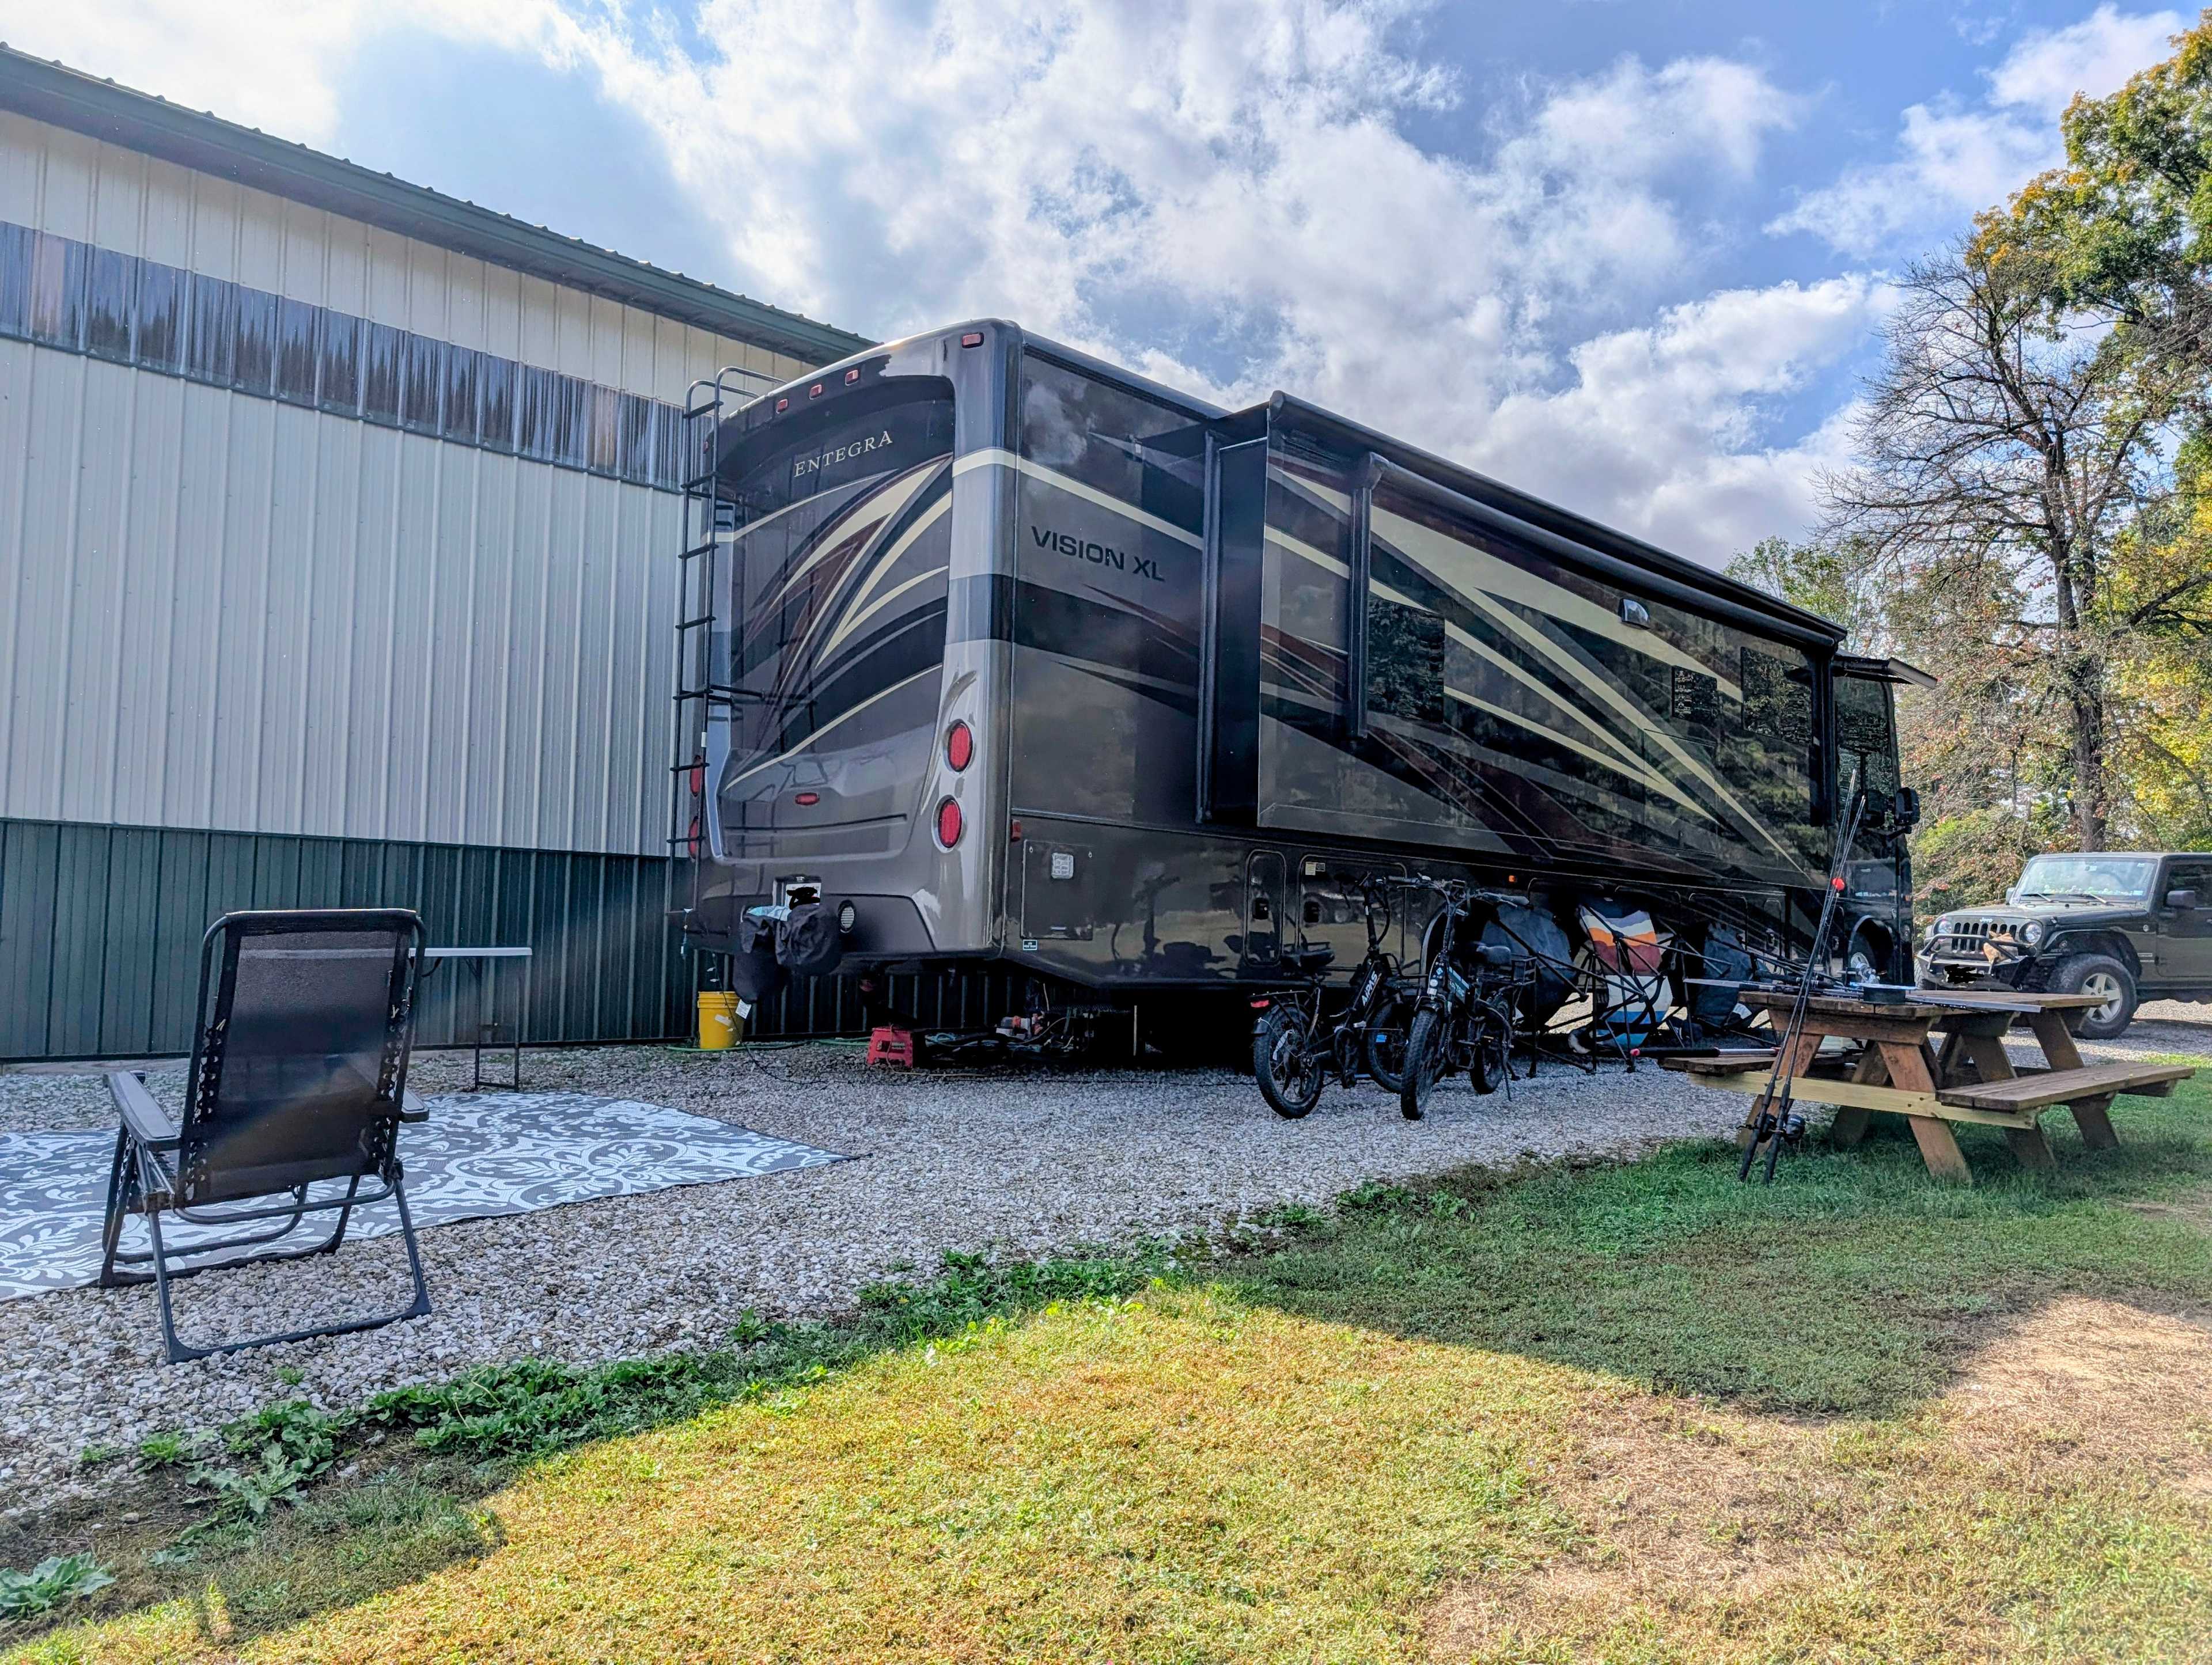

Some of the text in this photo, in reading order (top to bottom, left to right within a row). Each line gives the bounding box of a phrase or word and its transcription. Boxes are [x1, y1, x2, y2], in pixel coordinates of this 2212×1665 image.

[794, 431, 893, 477] ENTEGRA
[1031, 526, 1165, 582] VISION XL
